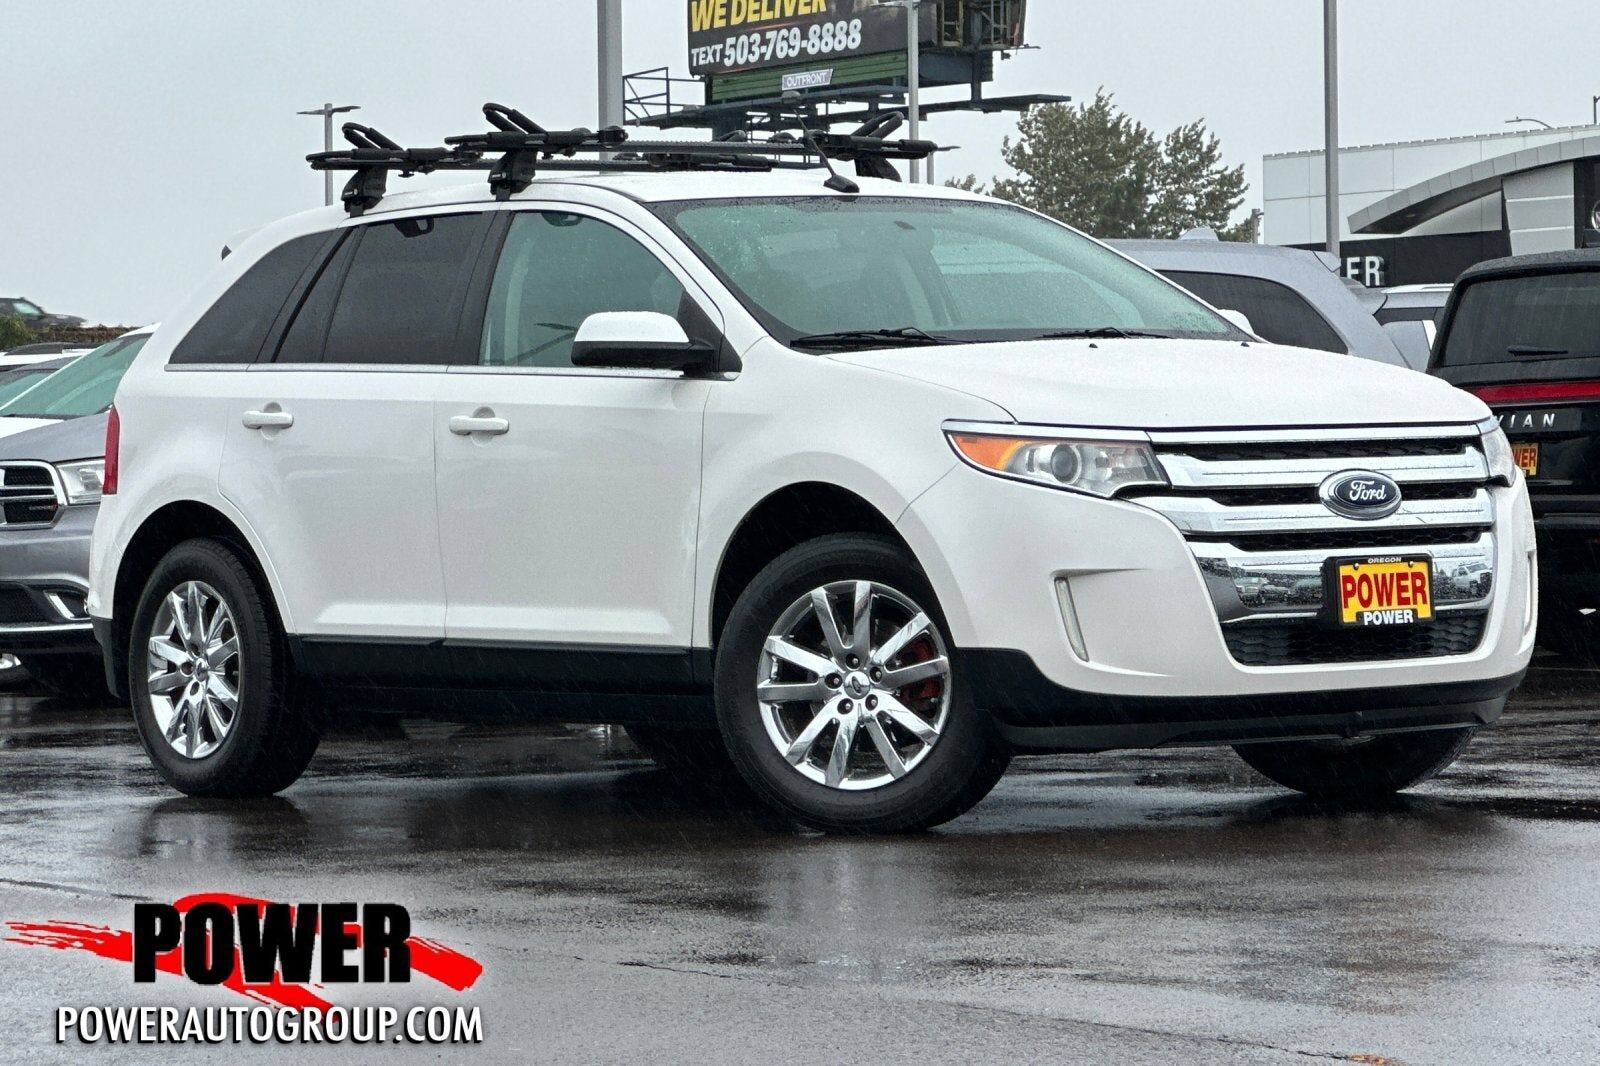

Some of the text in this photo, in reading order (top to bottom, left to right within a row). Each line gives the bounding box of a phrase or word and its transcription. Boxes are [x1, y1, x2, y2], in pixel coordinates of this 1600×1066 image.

[691, 0, 727, 32] WE
[692, 18, 862, 67] TEXT 503-769-8888
[786, 71, 828, 88] OUTFRONT
[1349, 480, 1387, 501] Ford
[1367, 556, 1402, 564] OREGON
[1341, 571, 1428, 609] POWER
[1363, 609, 1414, 626] POWER
